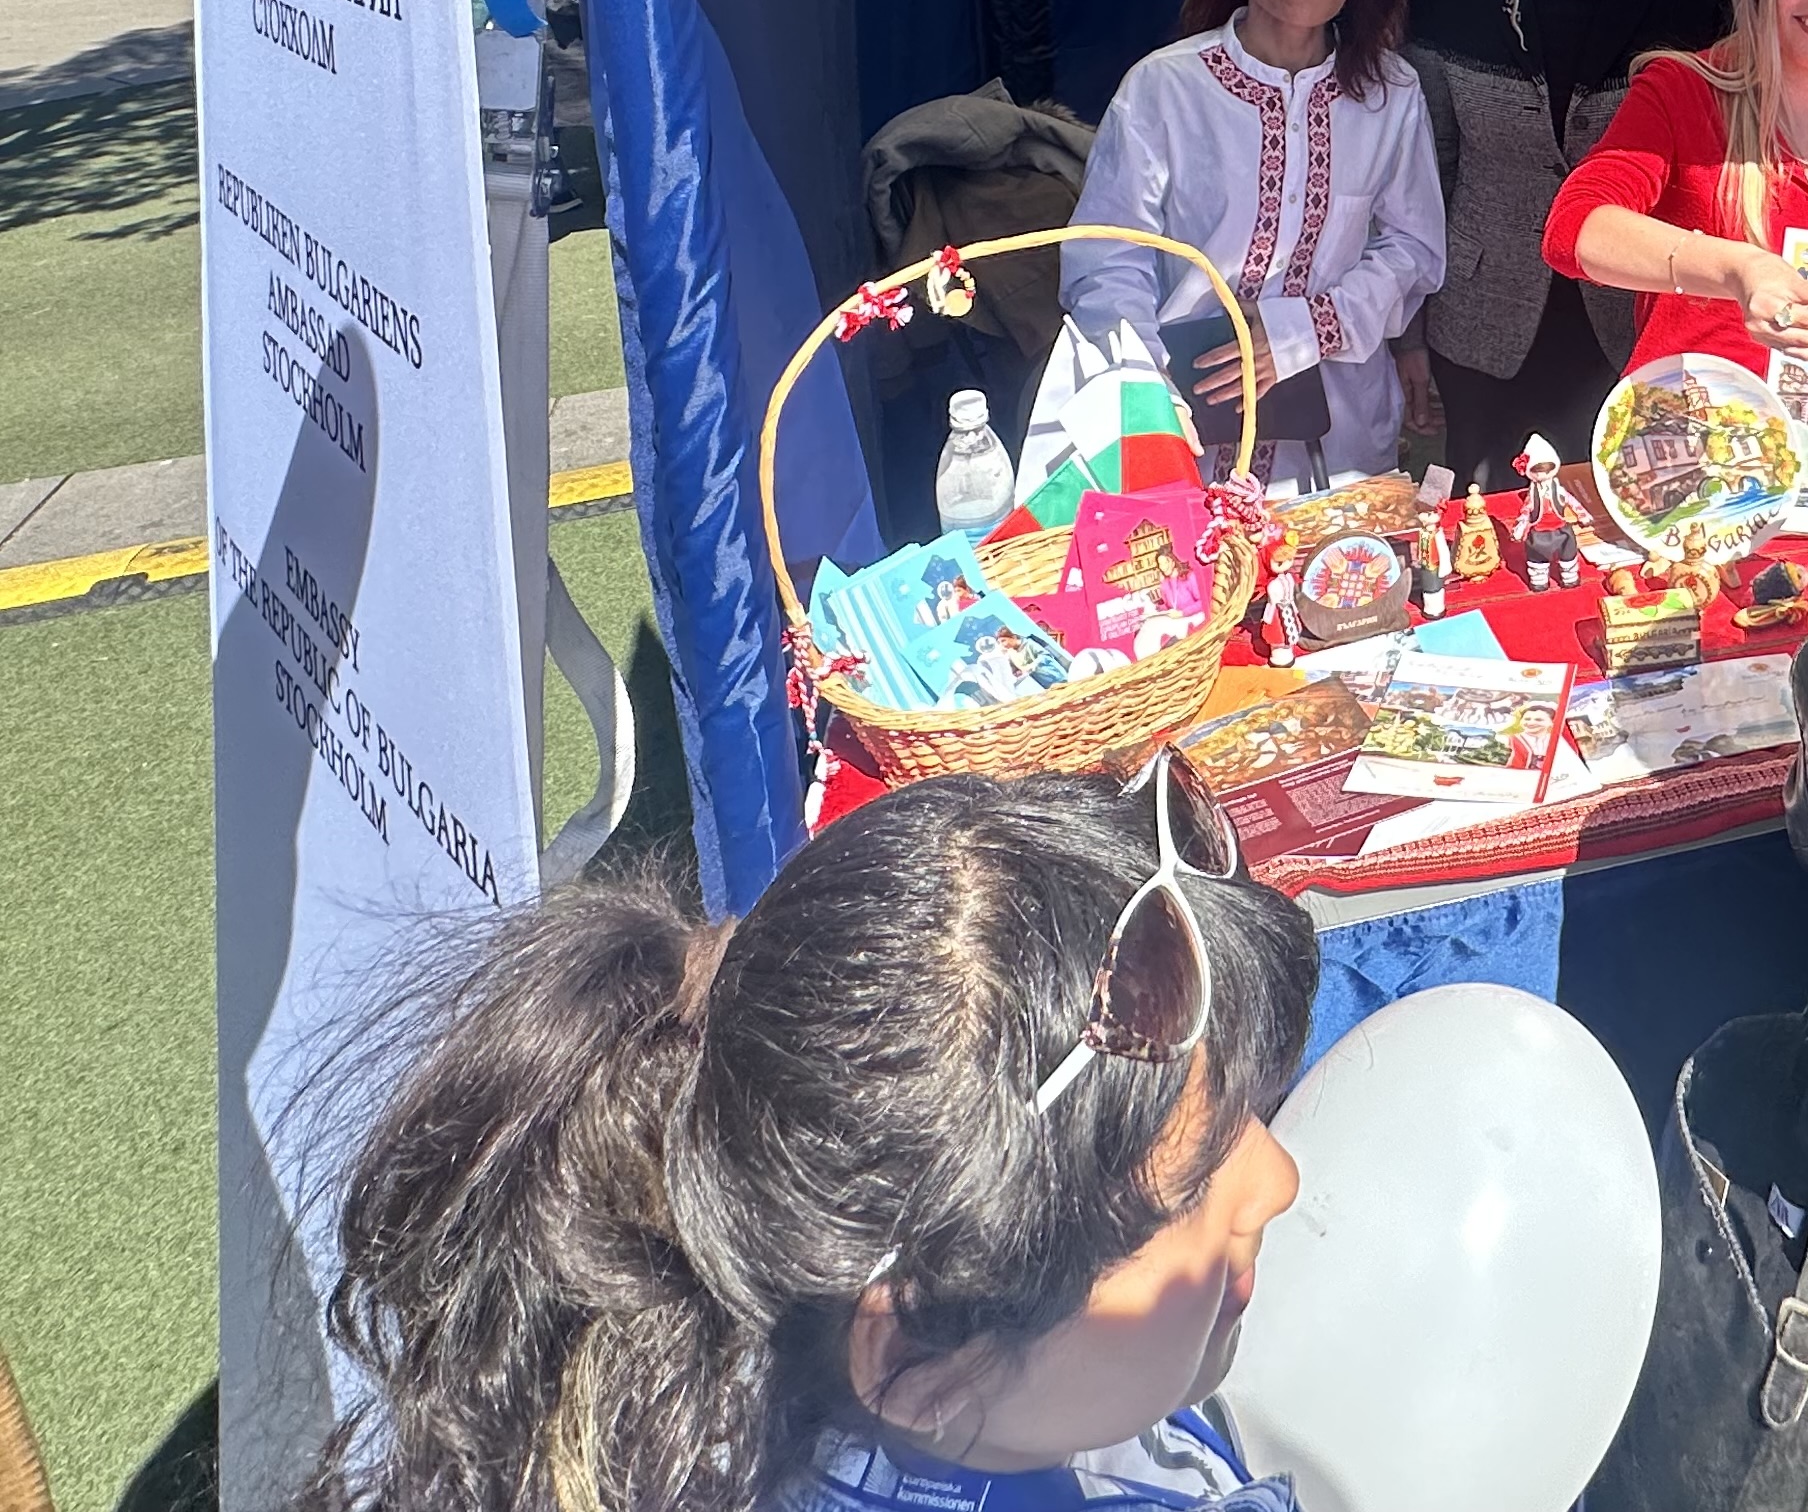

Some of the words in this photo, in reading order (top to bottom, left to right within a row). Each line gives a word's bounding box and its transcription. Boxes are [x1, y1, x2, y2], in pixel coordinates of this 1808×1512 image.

[217, 163, 301, 270] REPUBLIKEN
[303, 231, 423, 369] BULGARIENS
[267, 269, 350, 382] AMBASSAD
[262, 330, 366, 473] STOCKHOLM
[284, 545, 360, 674] EMBASSY
[215, 515, 228, 567] OF
[229, 539, 258, 609] THE
[260, 577, 341, 715] REPUBLIC
[345, 688, 372, 752] OF
[376, 723, 501, 909] BULGARIA
[275, 659, 390, 846] STOCKHOLM
[896, 1485, 976, 1511] kommissionen
